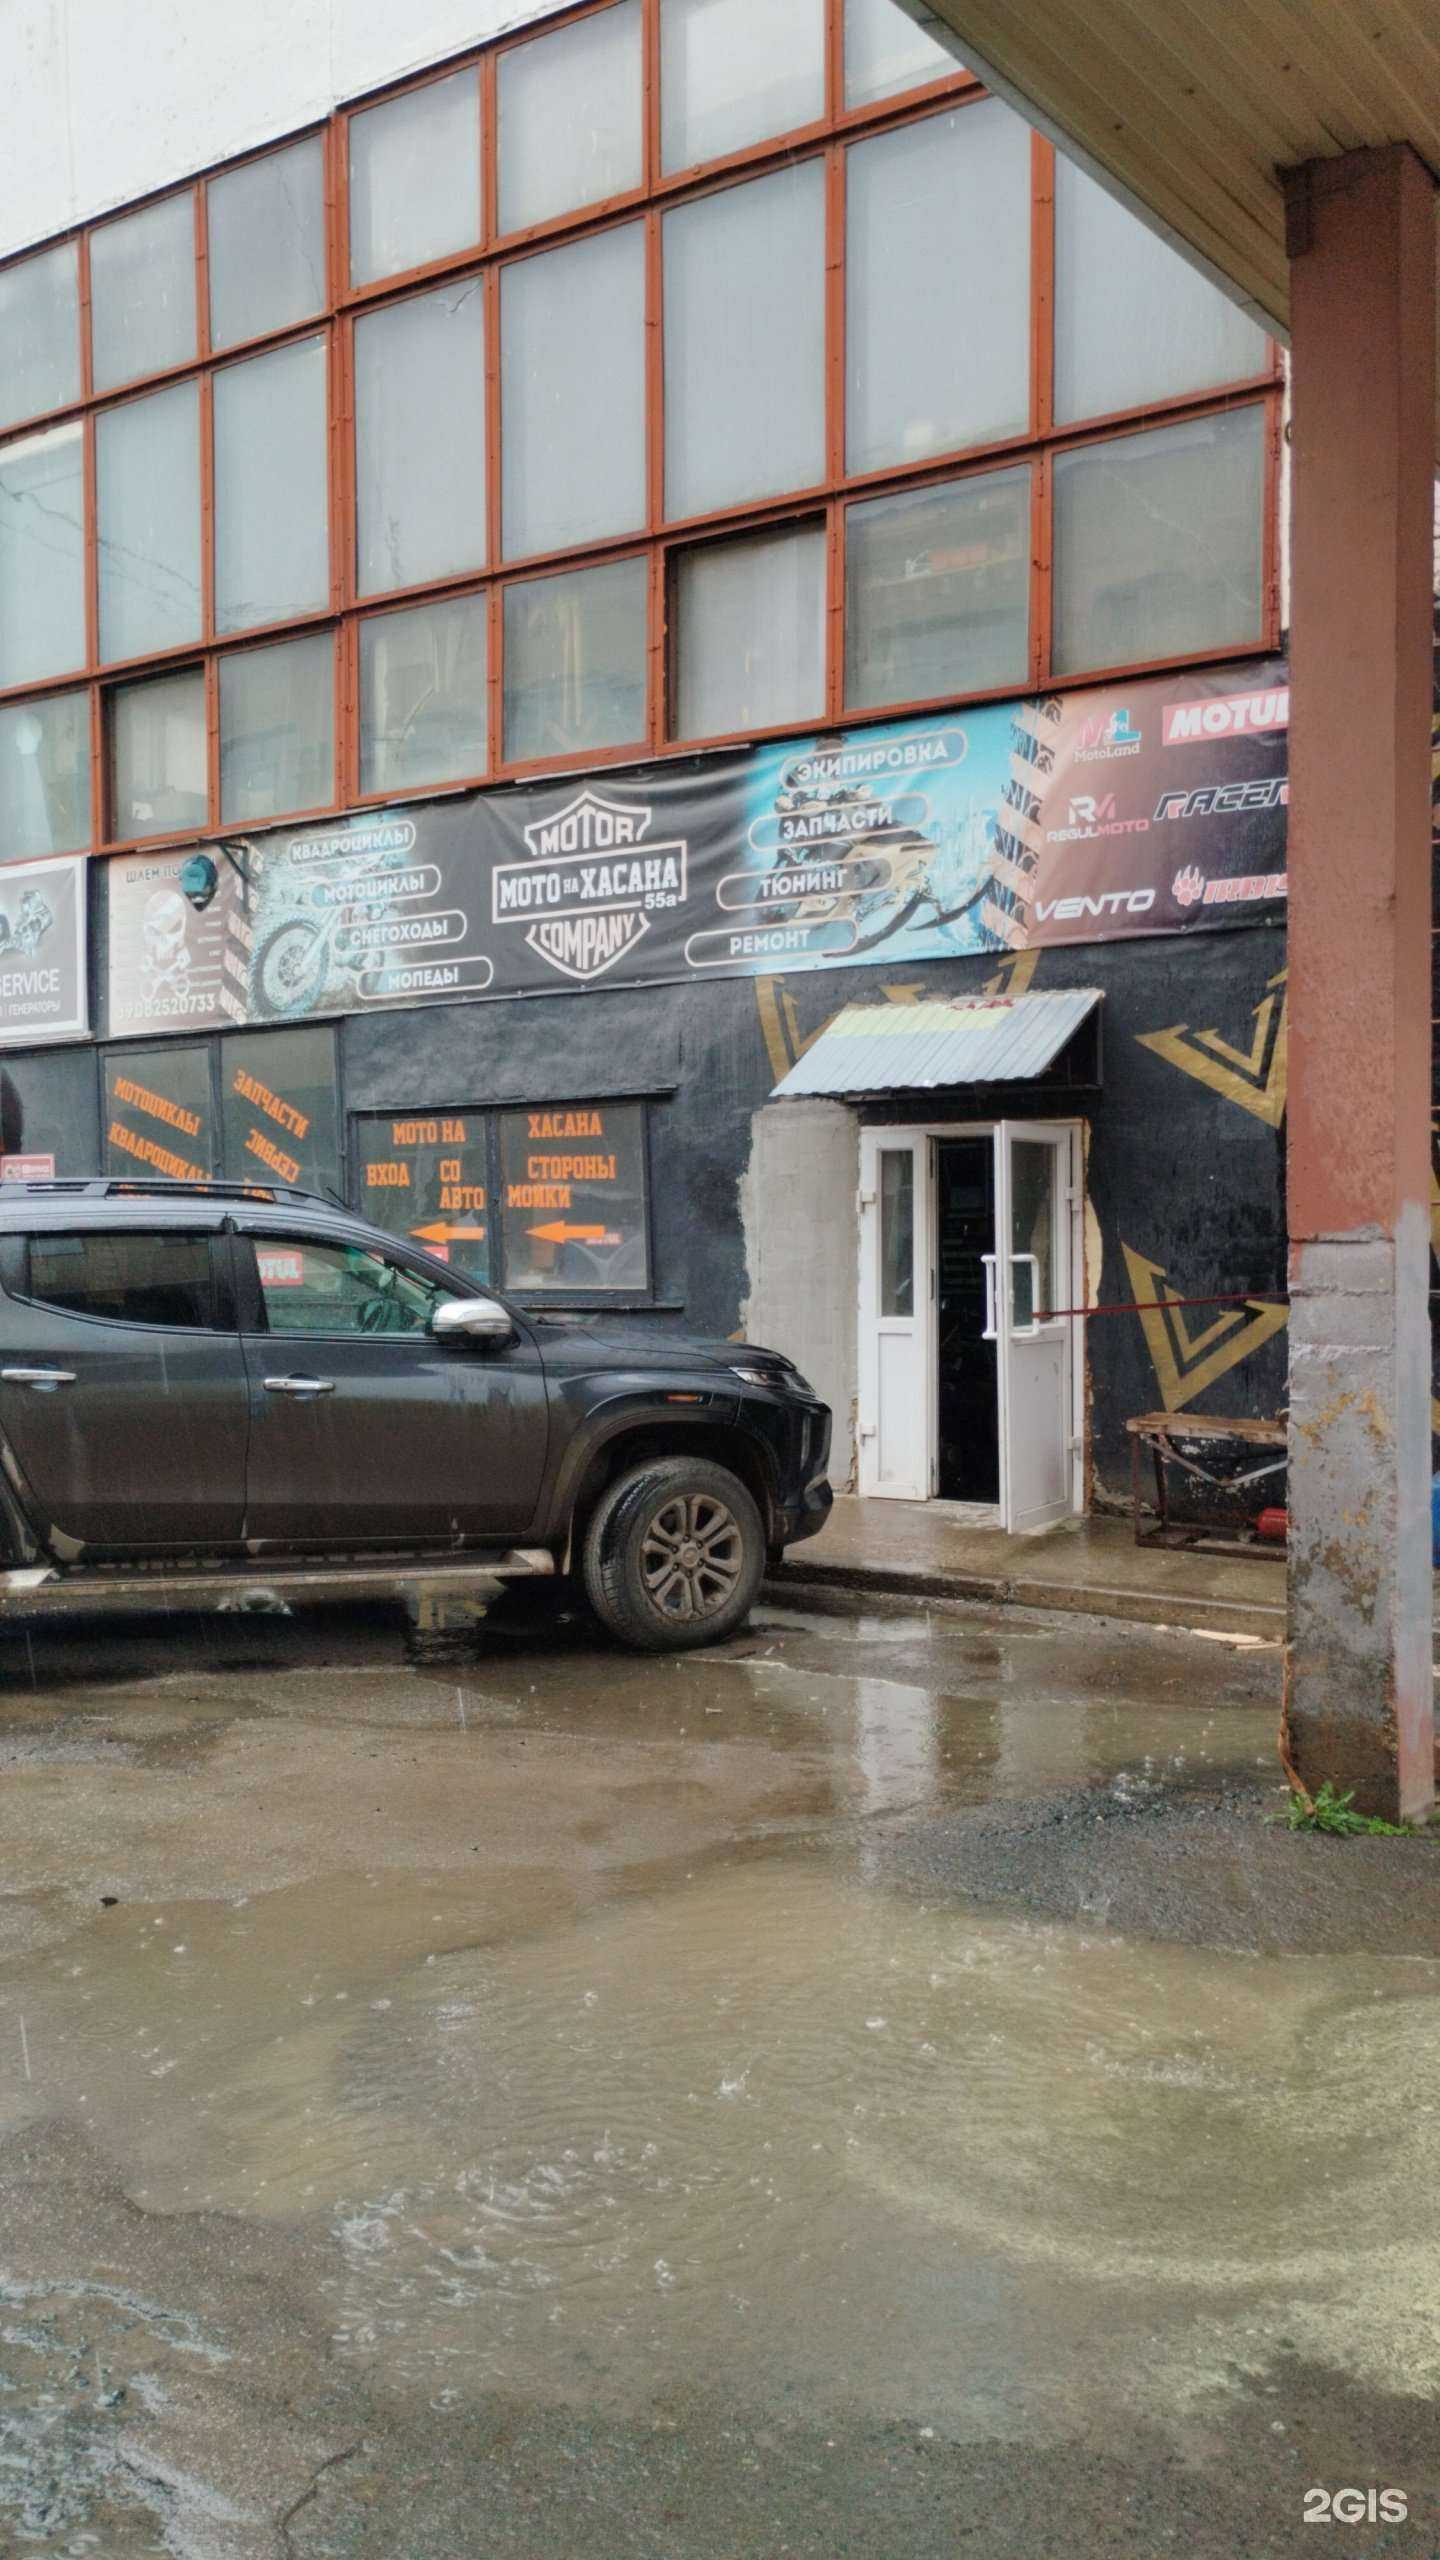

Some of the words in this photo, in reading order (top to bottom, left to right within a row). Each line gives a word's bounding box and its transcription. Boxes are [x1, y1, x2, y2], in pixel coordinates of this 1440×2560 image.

[798, 739, 949, 781] ЭКИПИРОВКА
[1074, 743, 1140, 763] MotoLand
[540, 803, 634, 855] MOTOR
[783, 806, 893, 839] ЗАПЧАСТИ
[1047, 819, 1149, 843] REGULMOTO
[292, 827, 409, 862] КВАДРОЦИКЛЫ
[323, 872, 425, 902] МОТОЦИКЛЫ
[500, 873, 561, 909] МОТО
[563, 877, 579, 895] НА
[580, 857, 679, 899] ХАСАНА
[760, 868, 848, 897] ТЮНИНГ
[1035, 889, 1156, 923] VENTO
[350, 919, 449, 945] СНЕГОХОДЫ
[539, 913, 635, 970] COMPANY
[729, 929, 811, 955] РЕМОНТ
[0, 969, 61, 998] ERVICE
[387, 966, 459, 991] МОПЕДЫ
[113, 1077, 202, 1137] МОТОЦИКЛЫ
[233, 1068, 309, 1140] ЗАПЧАСТИ
[393, 1121, 437, 1145] МОТО
[441, 1120, 466, 1143] НА
[528, 1112, 602, 1138] ХАСАНА
[366, 1163, 410, 1187] ВХОД
[439, 1160, 462, 1182] СО
[528, 1155, 616, 1180] СТОРОНЫ
[439, 1187, 485, 1210] АВТО
